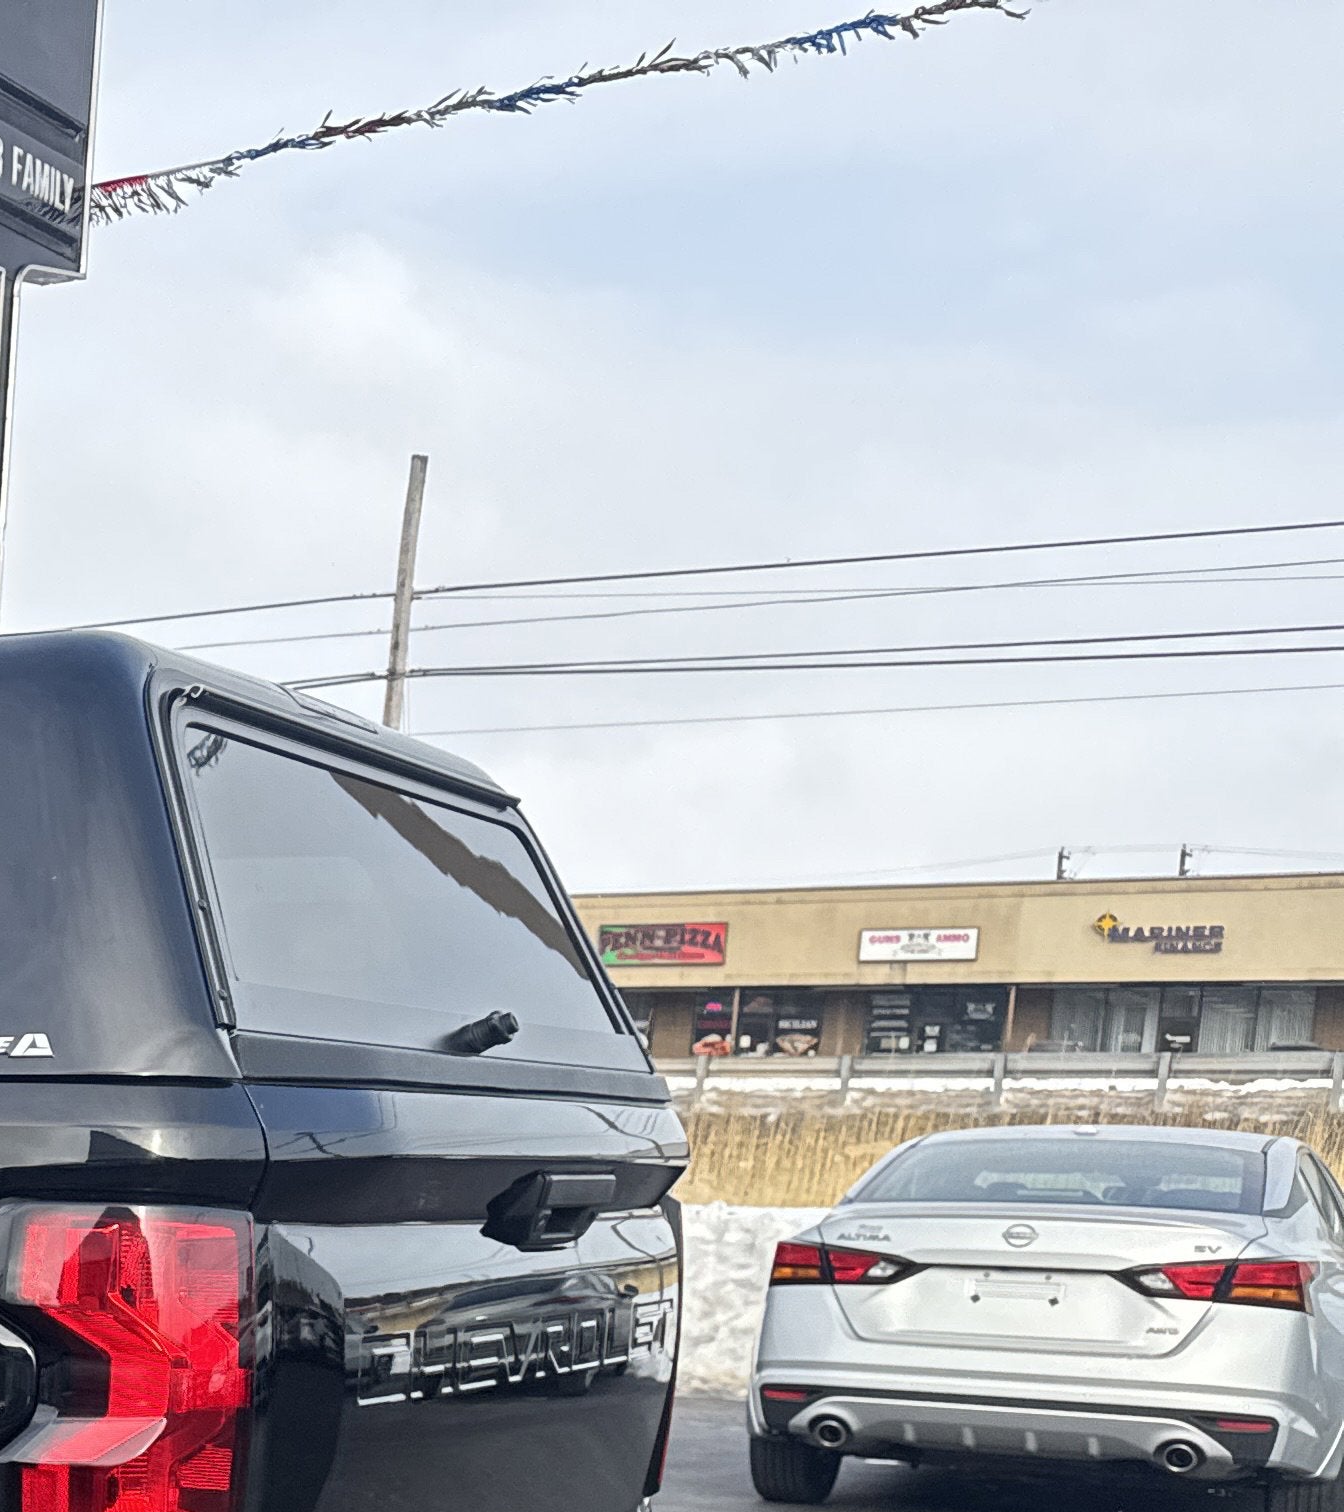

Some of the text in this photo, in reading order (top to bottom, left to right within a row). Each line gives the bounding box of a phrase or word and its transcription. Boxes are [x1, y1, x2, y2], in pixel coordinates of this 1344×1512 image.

[11, 144, 75, 214] FAMILY
[665, 926, 725, 953] PIZZA
[1108, 924, 1225, 943] MARINER
[836, 1232, 892, 1243] ALTIMA
[357, 1298, 674, 1407] CHEVROLET
